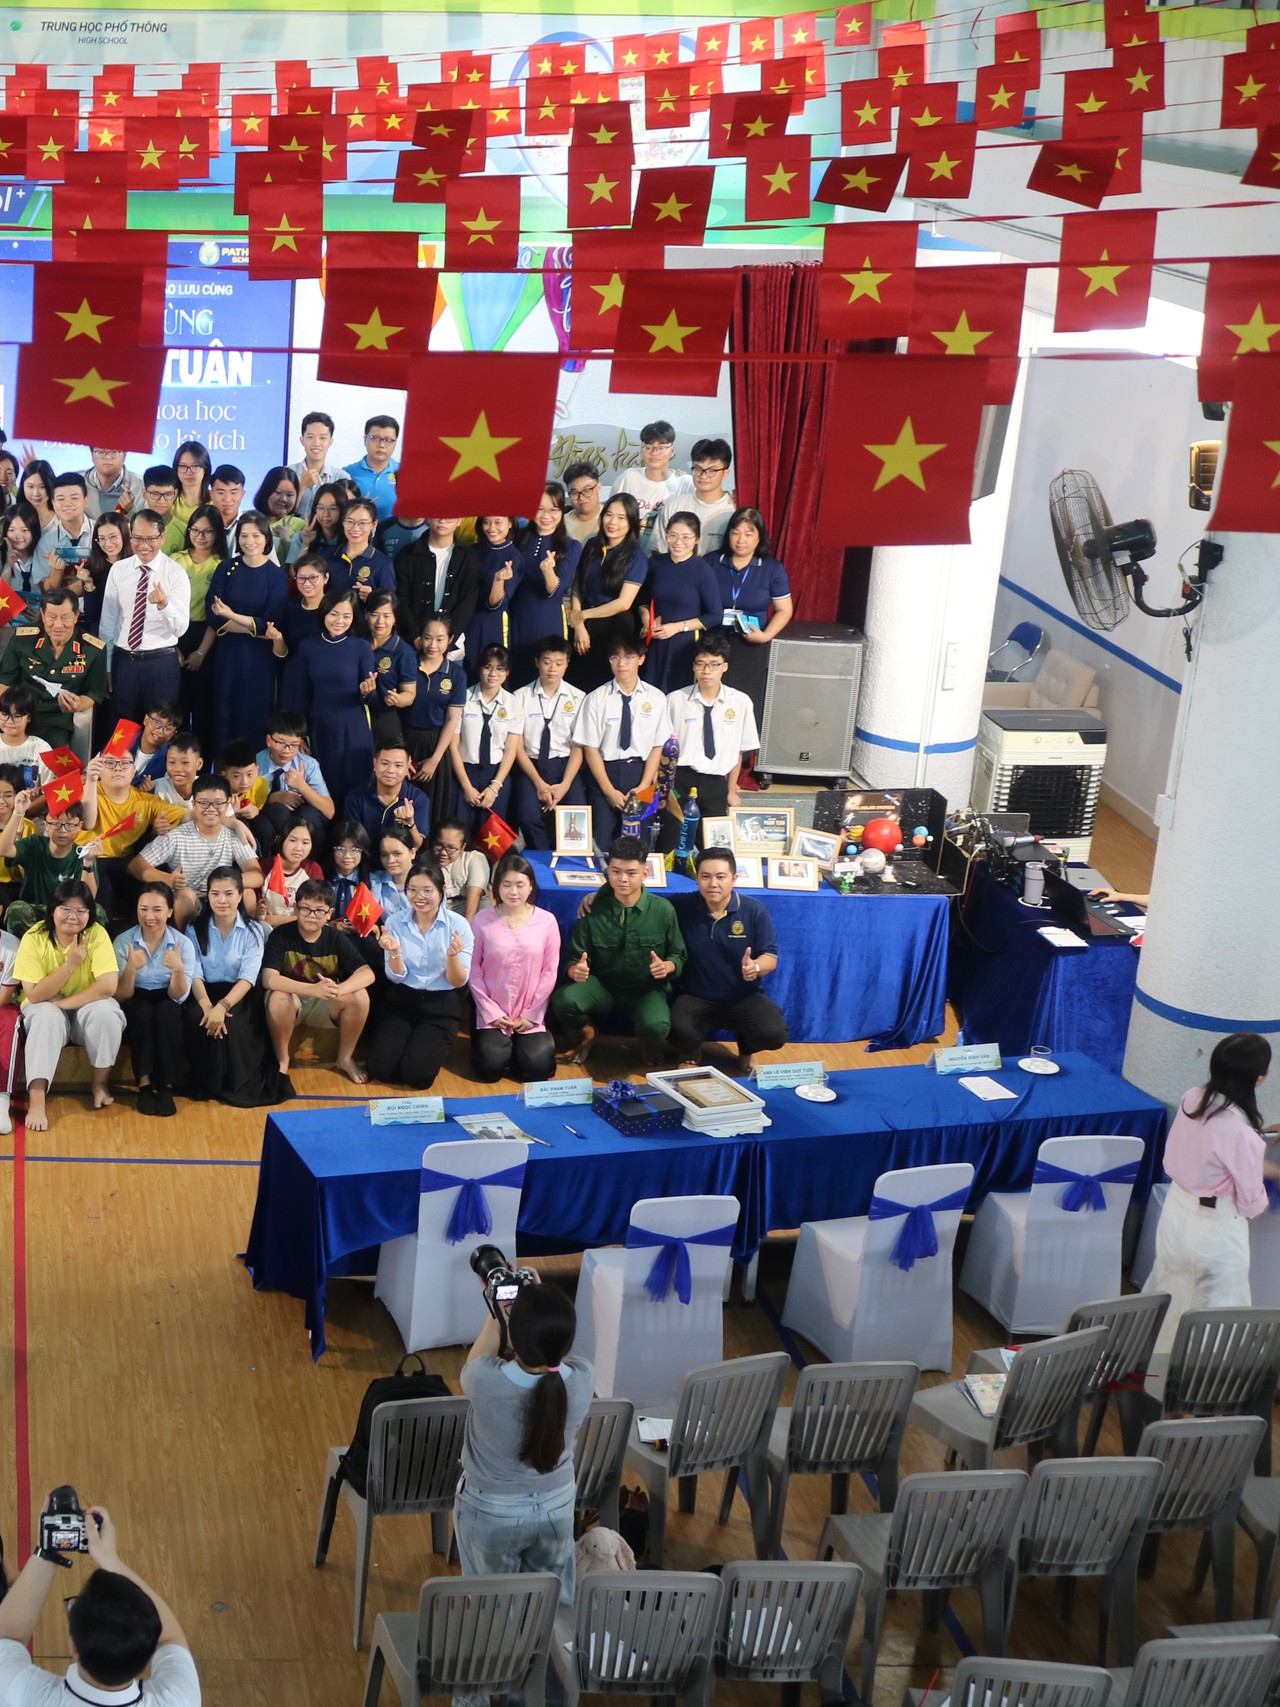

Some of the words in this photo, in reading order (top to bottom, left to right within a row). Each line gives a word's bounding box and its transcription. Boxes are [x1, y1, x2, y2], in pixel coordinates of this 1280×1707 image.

[41, 21, 77, 31] TRUNG
[78, 22, 103, 34] HỌC
[130, 20, 168, 33] THÔNG
[78, 36, 97, 44] HIGH
[98, 36, 128, 45] SCHOOL
[178, 283, 200, 295] LƯU
[202, 282, 233, 295] CÙNG
[195, 400, 237, 424] học
[208, 429, 246, 450] tích
